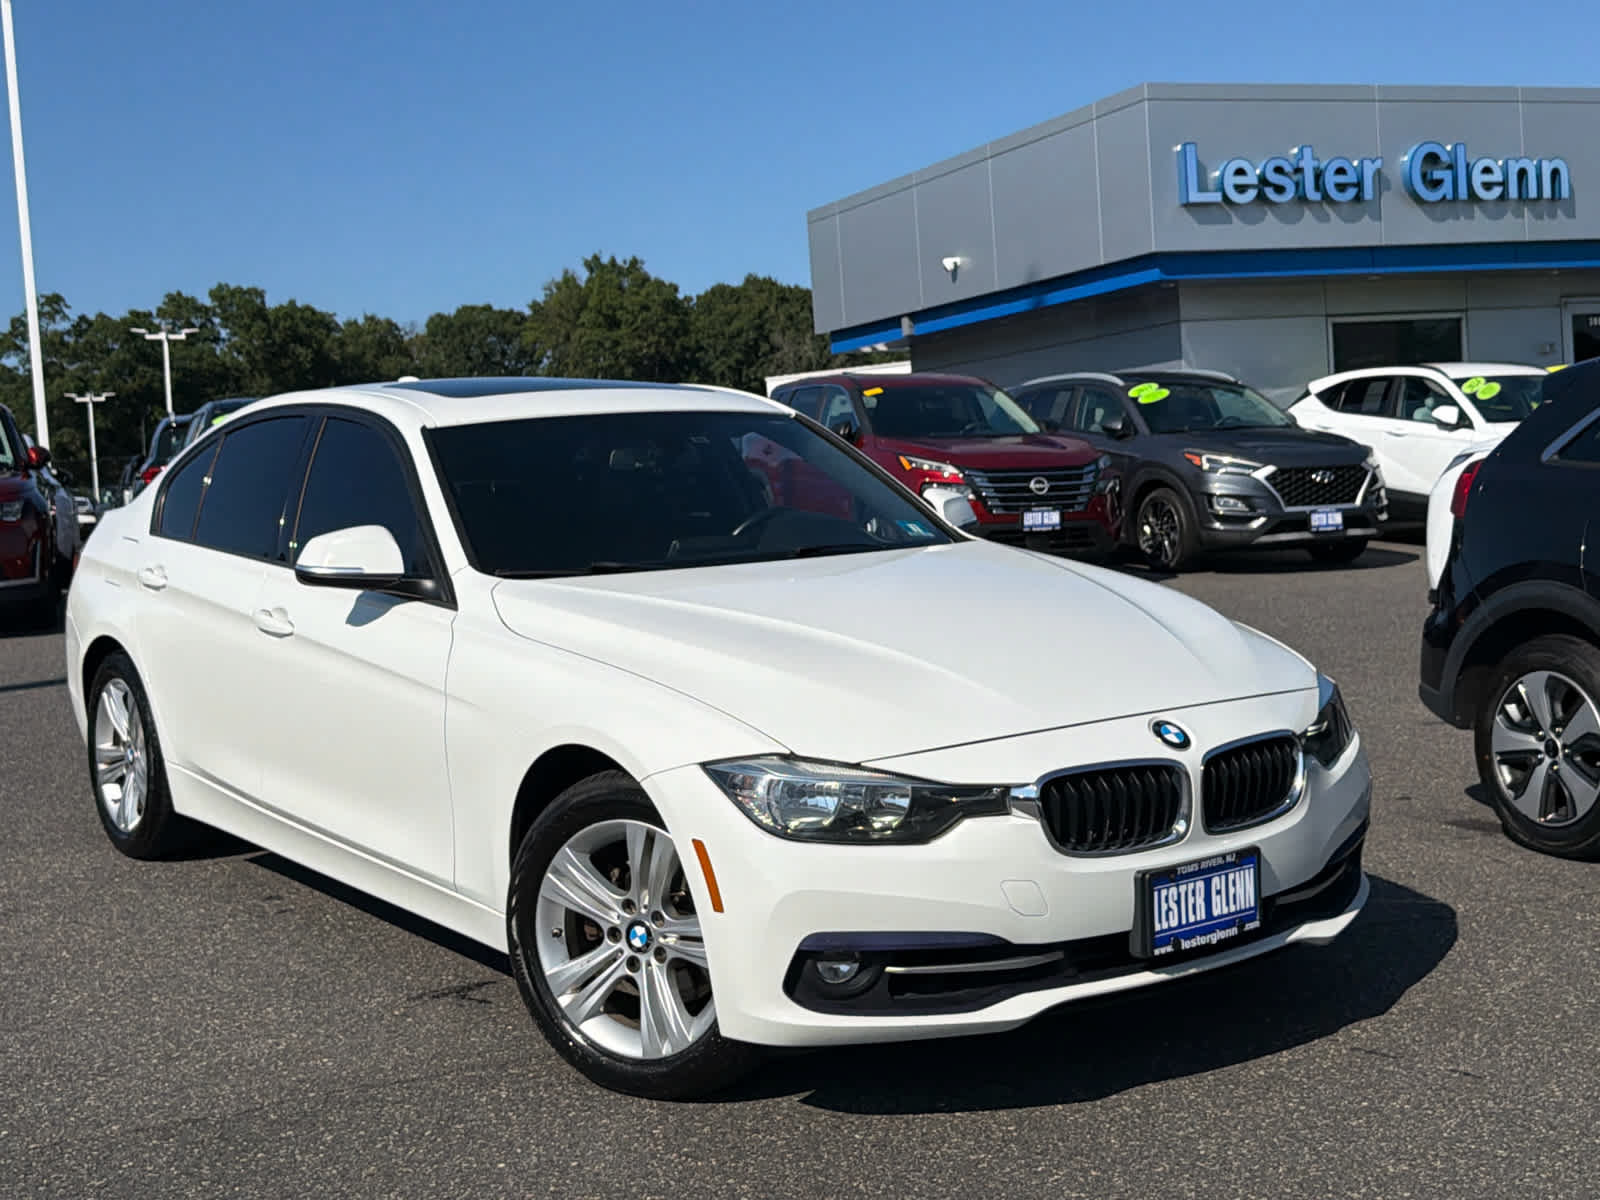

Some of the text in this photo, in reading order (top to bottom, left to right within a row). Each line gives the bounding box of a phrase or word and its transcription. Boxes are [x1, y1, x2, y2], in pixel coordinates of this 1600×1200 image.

[1176, 141, 1570, 205] Lester Glenn
[1153, 868, 1255, 932] LESTER GLENN
[1180, 926, 1238, 950] lesterglenn
